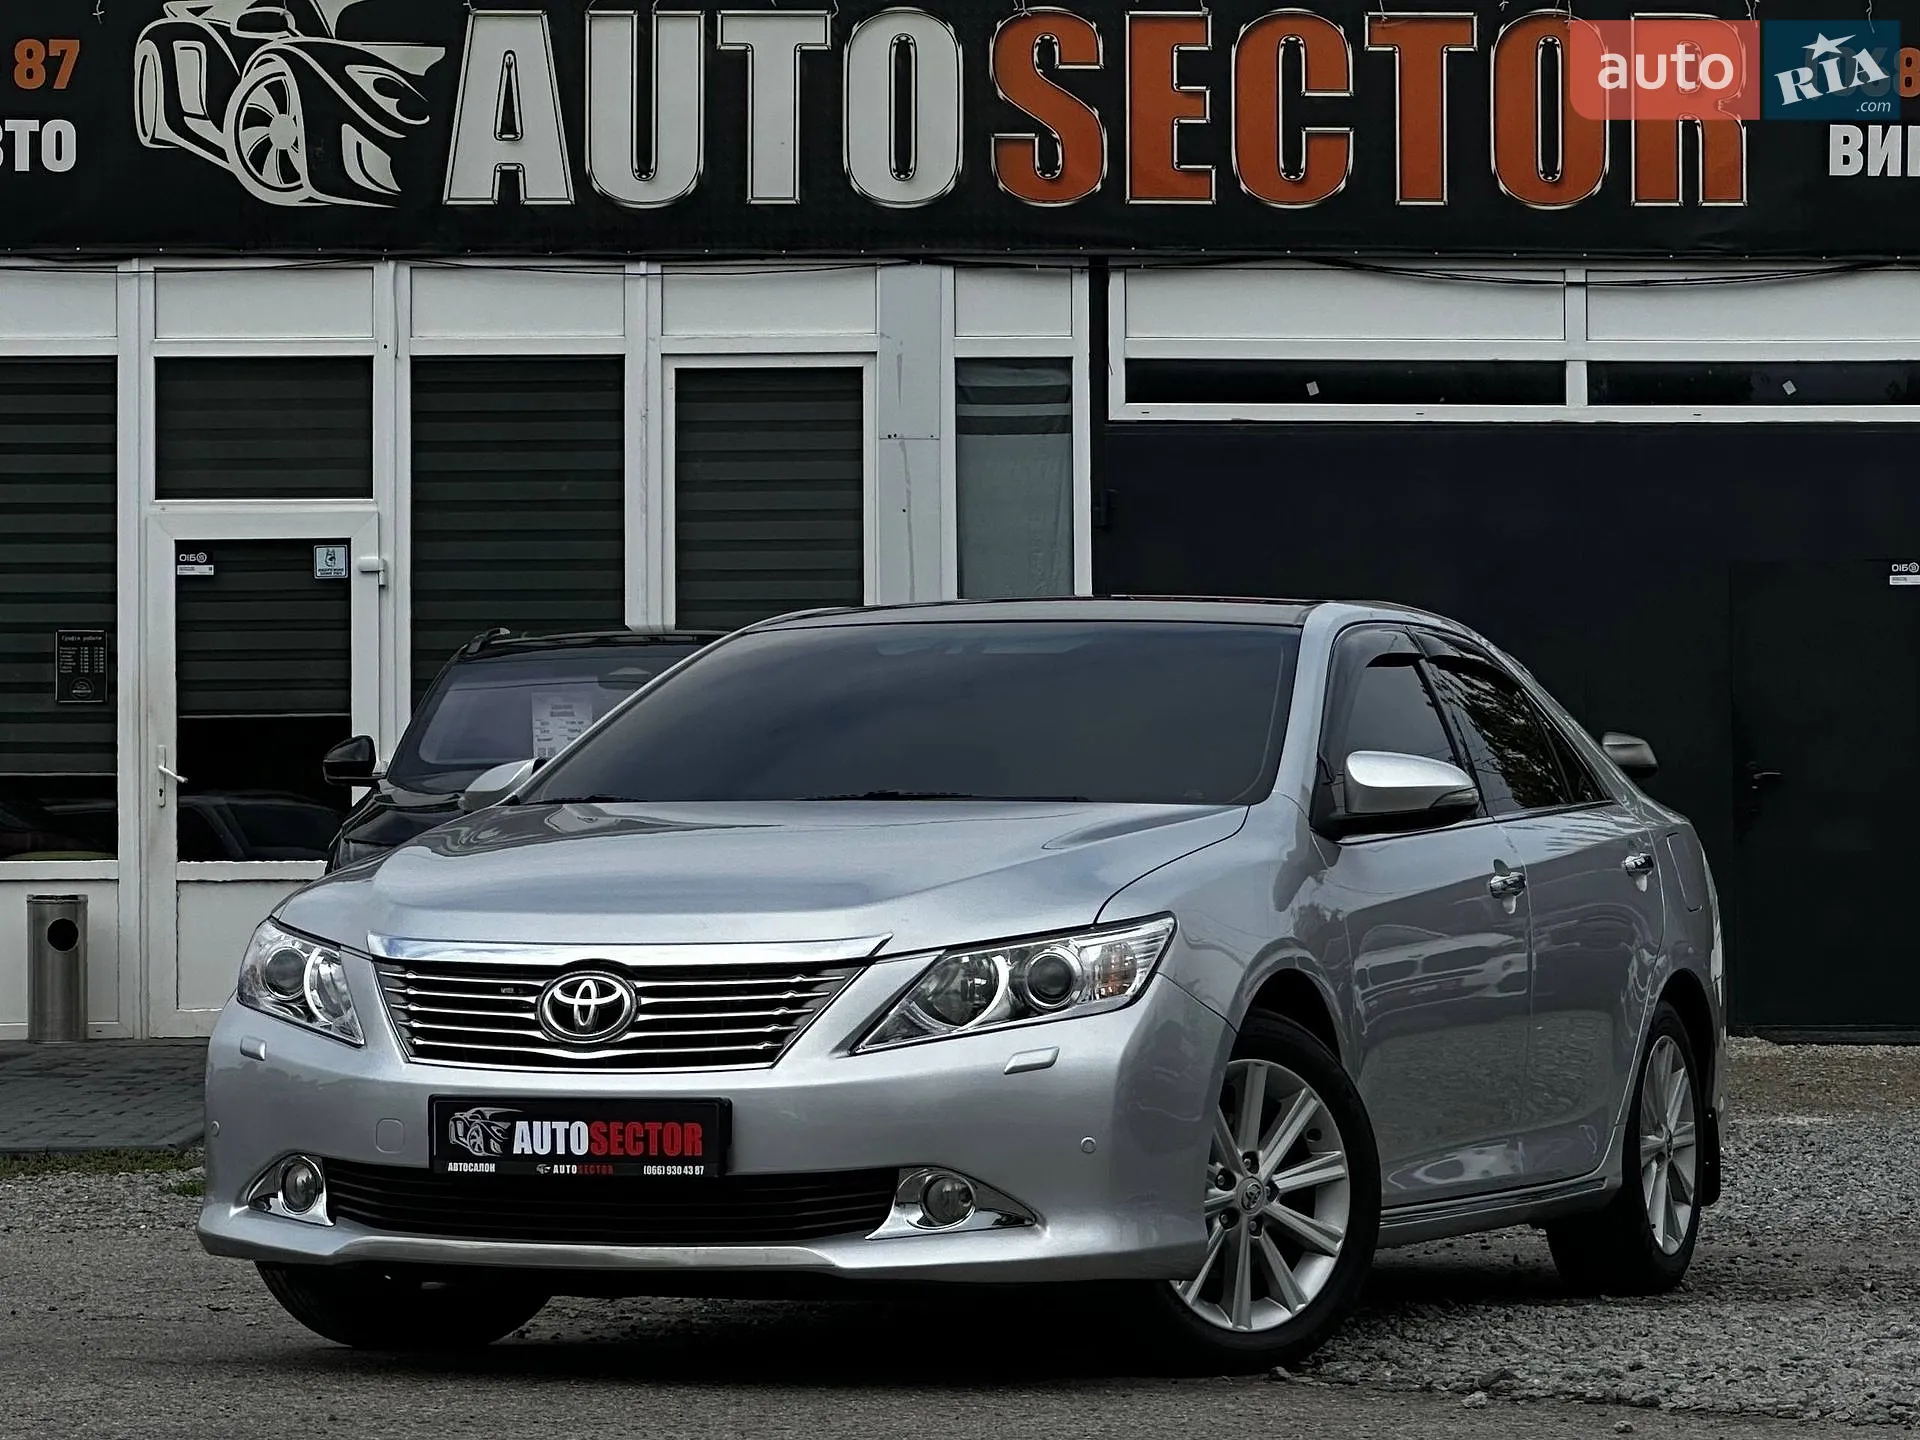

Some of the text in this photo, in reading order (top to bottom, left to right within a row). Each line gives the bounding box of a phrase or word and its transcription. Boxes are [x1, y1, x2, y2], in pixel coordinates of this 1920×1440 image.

[14, 38, 80, 90] 87
[0, 119, 76, 172] ТО
[447, 1162, 496, 1173] АВТОСАЛОН
[643, 1165, 705, 1175] (066) 930 43 87
